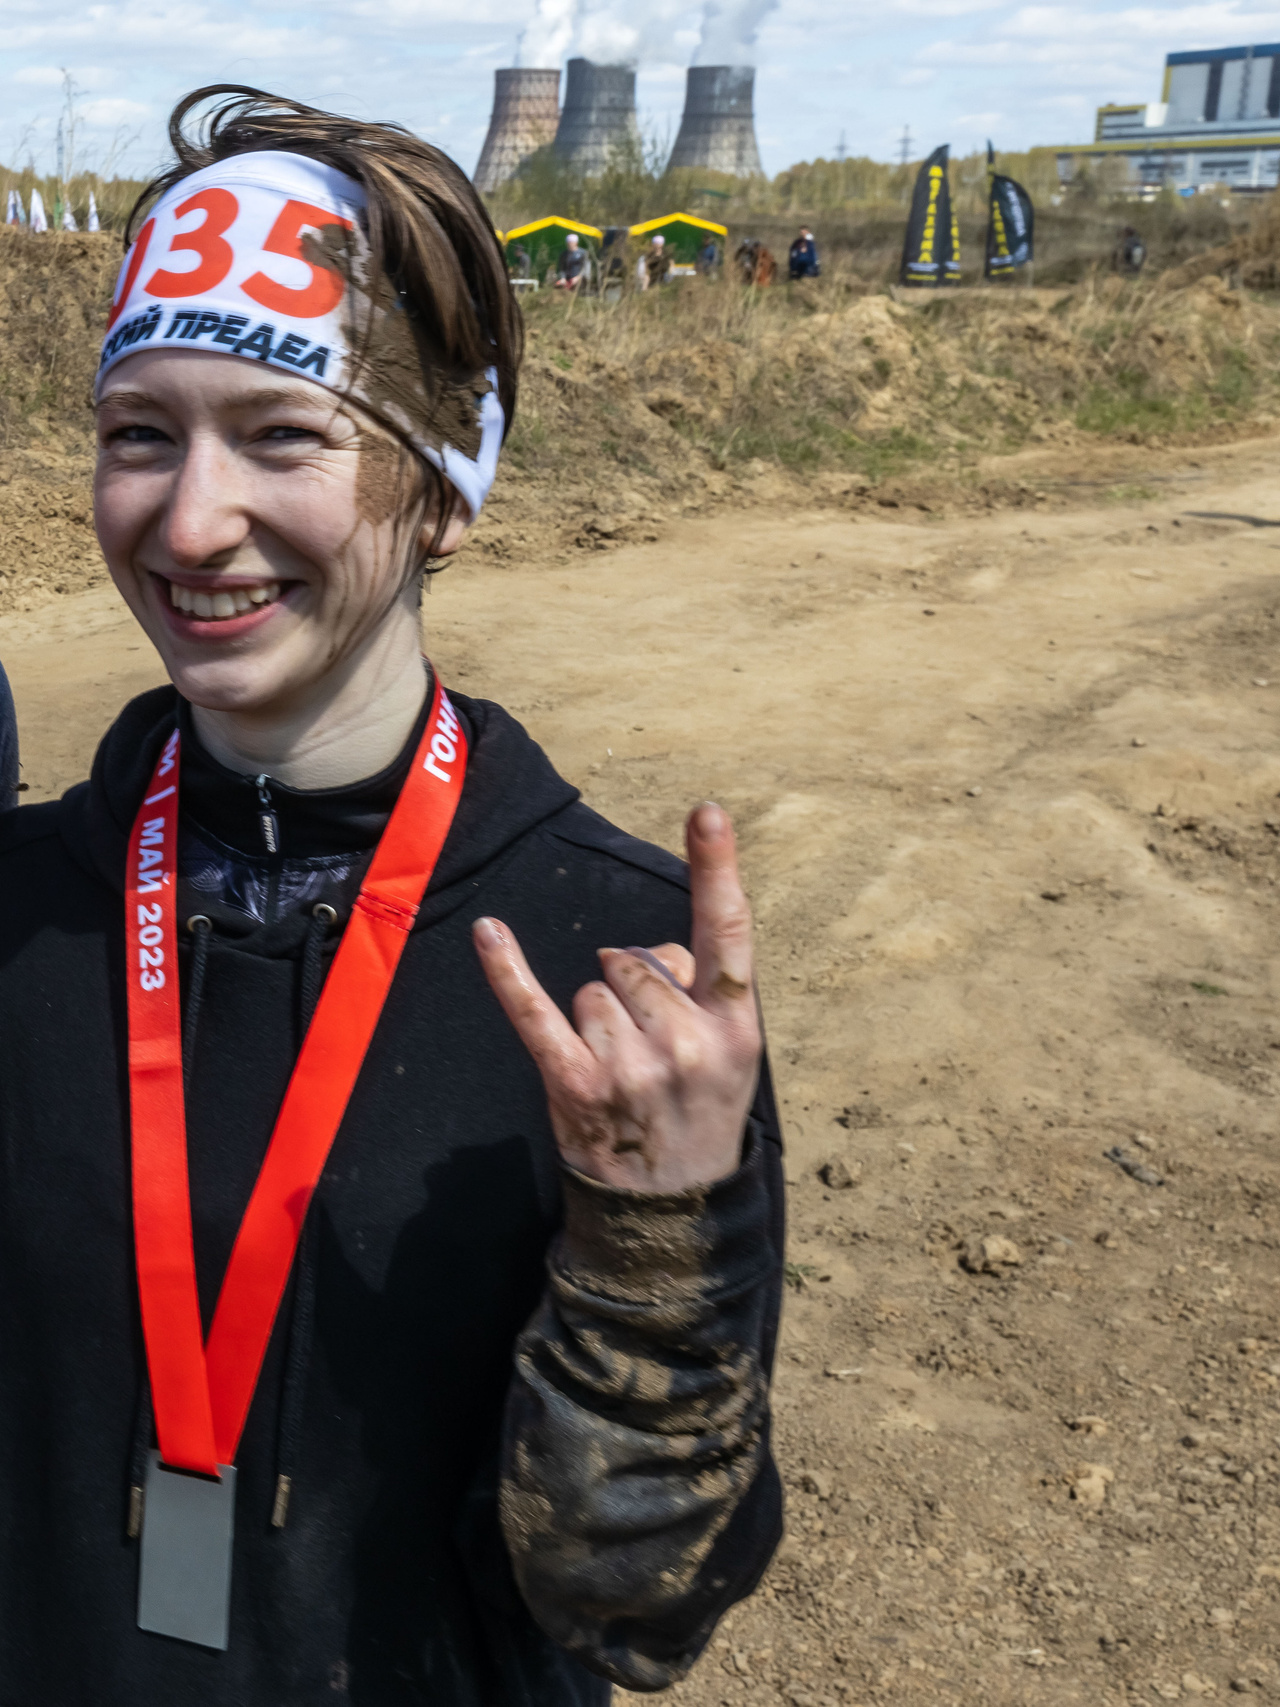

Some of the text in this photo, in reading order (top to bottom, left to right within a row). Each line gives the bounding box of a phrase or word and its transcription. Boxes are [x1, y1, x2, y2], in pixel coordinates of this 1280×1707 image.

[163, 310, 331, 377] ПРЕДЕЛ
[137, 816, 171, 894] МАЙ
[137, 901, 166, 992] 2023
